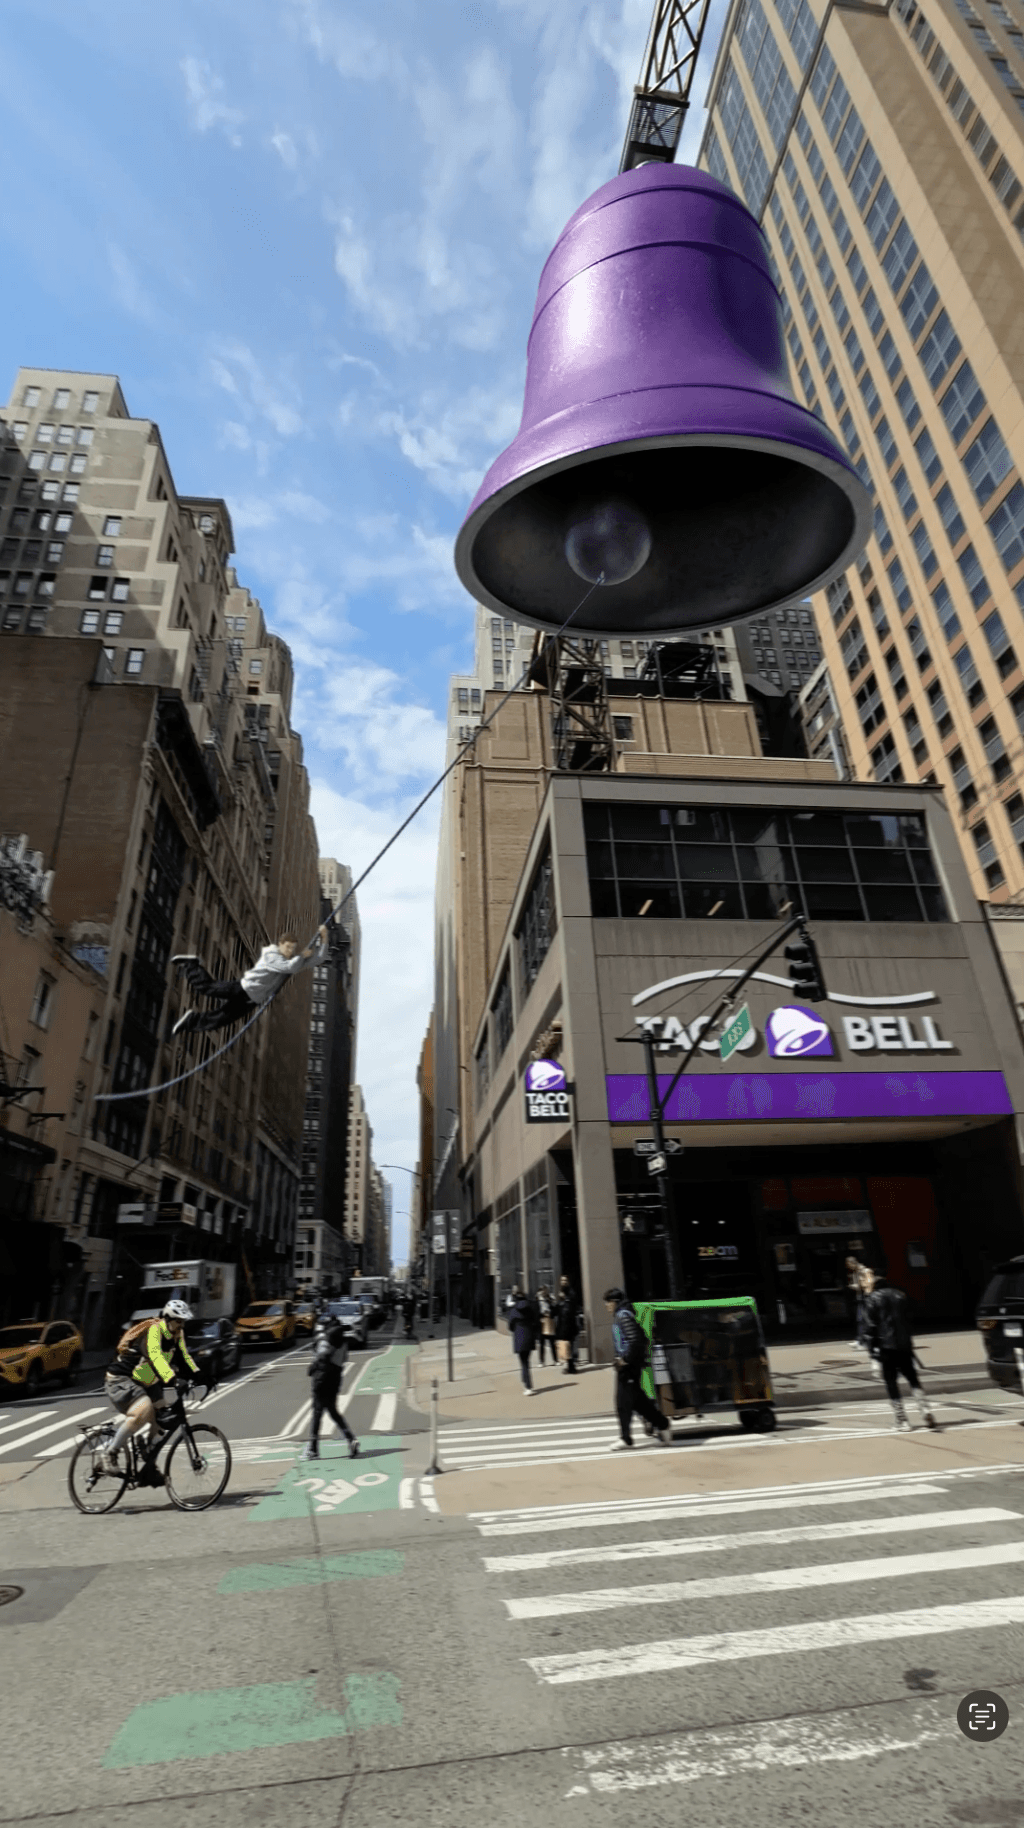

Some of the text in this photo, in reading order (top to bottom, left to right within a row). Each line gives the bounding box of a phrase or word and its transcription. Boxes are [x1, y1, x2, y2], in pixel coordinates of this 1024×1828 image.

[841, 1016, 954, 1050] BELL
[525, 1092, 568, 1104] TACO
[529, 1104, 570, 1117] BELL
[154, 1268, 189, 1282] FedEx
